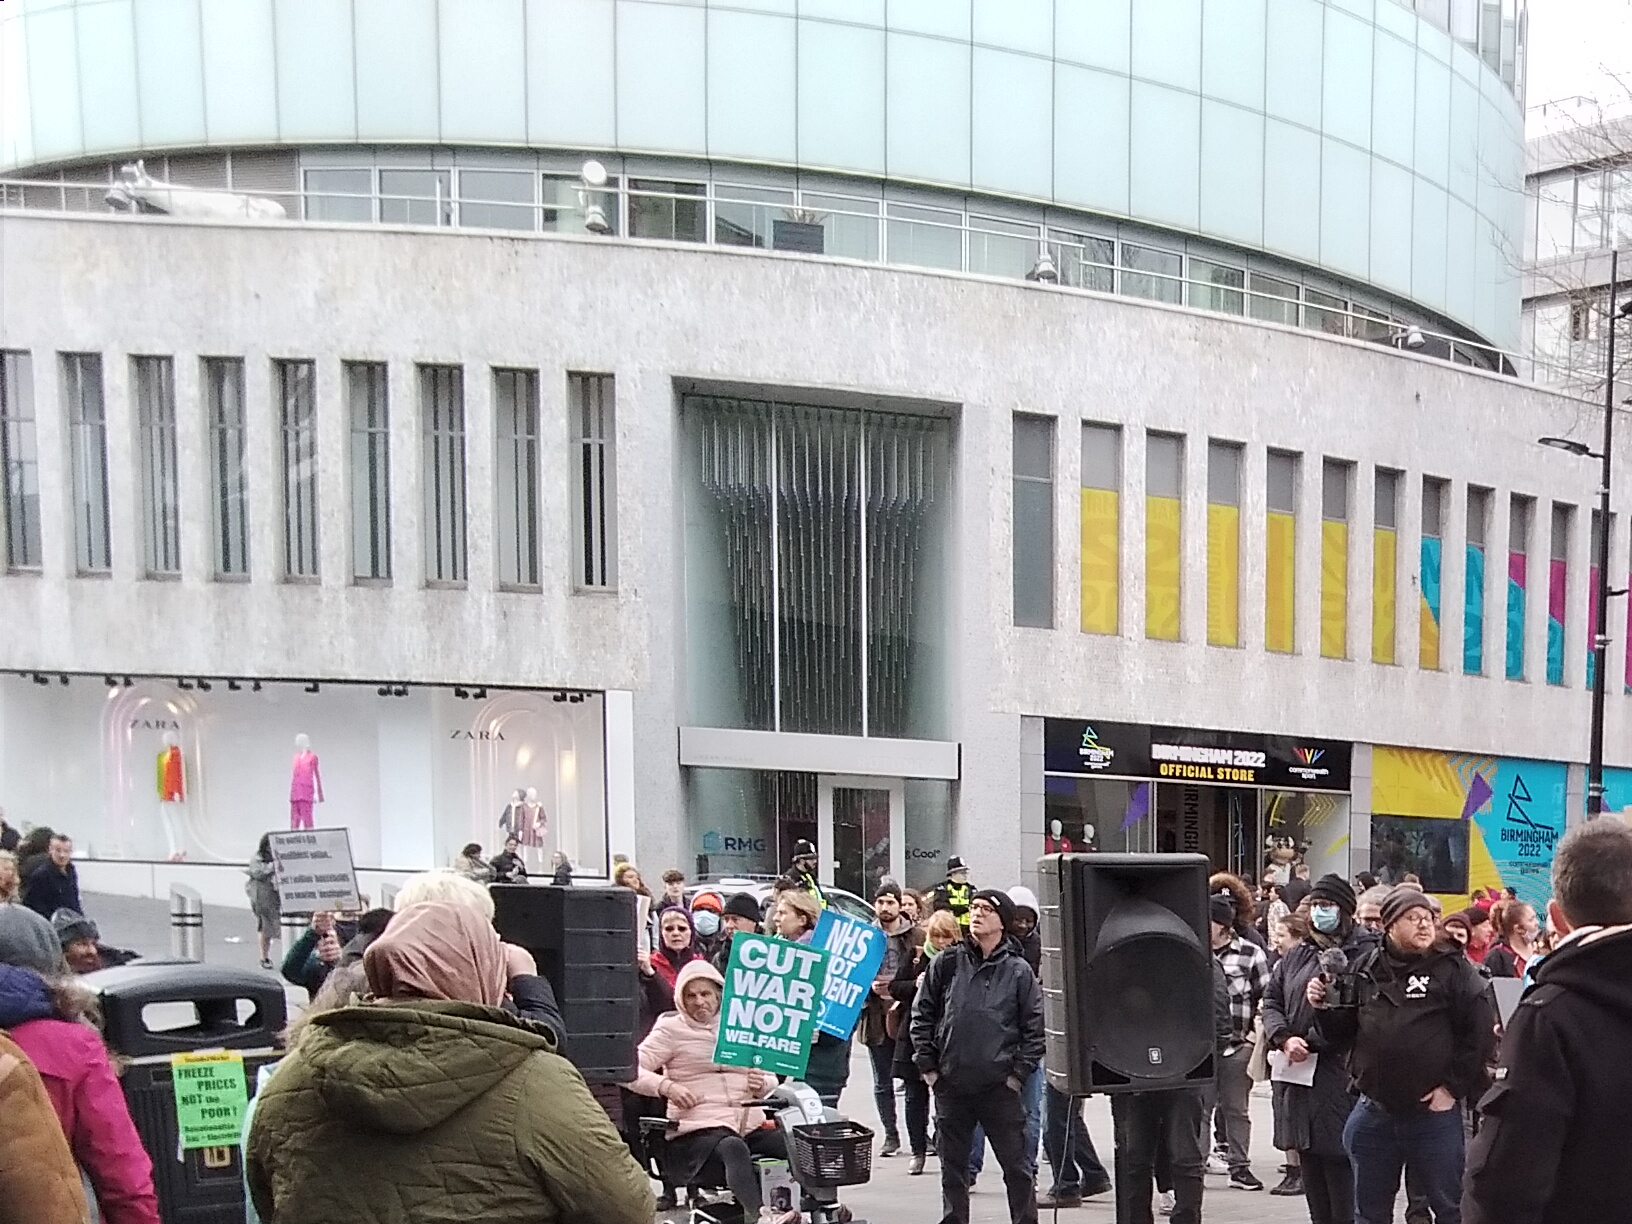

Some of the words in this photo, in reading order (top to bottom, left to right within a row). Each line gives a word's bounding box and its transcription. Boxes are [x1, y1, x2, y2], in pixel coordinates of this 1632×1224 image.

[131, 719, 179, 729] ZARA
[450, 730, 505, 741] ZARA
[1152, 743, 1233, 765] BIRMINGHAM
[1234, 750, 1266, 768] 2022
[1159, 763, 1214, 779] OFFICIAL
[1217, 767, 1255, 782] STORE
[724, 836, 768, 851] RMG
[1501, 828, 1559, 844] BIRMINGHAM
[1518, 843, 1541, 857] 2022
[825, 918, 873, 962] NHS
[739, 939, 822, 980] CUT
[733, 968, 816, 1010] WAR
[727, 997, 810, 1038] NOT
[725, 1028, 802, 1055] WELFARE
[178, 1067, 214, 1079] FREEZE
[197, 1078, 237, 1091] PRICES
[181, 1094, 202, 1105] NOT
